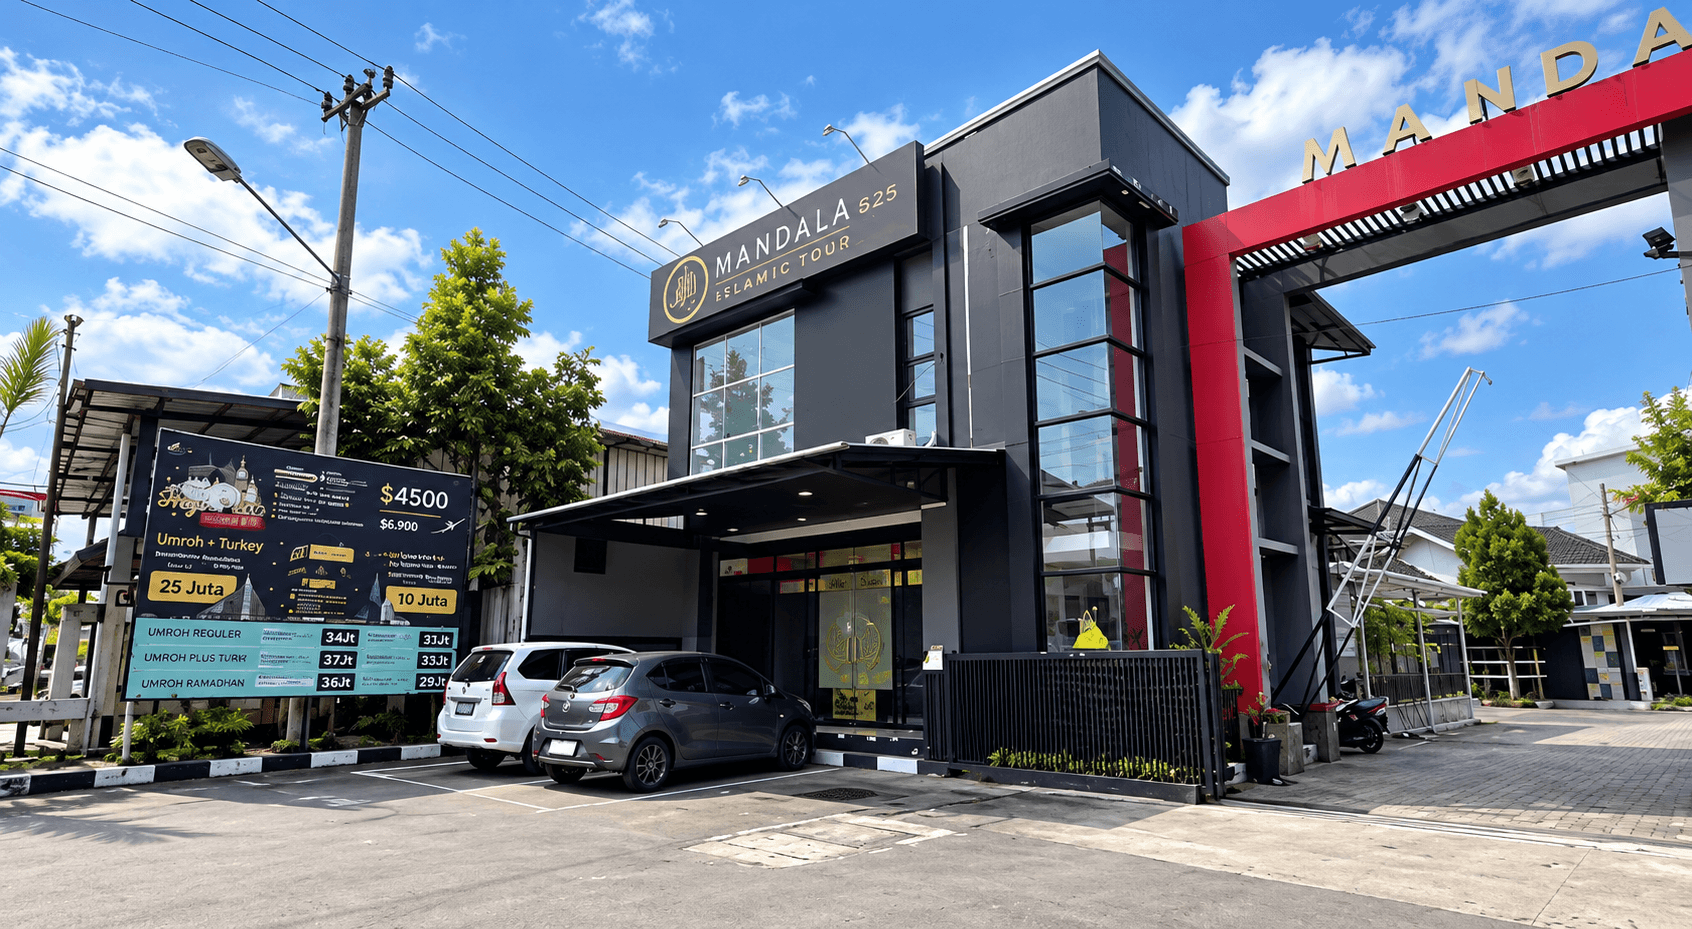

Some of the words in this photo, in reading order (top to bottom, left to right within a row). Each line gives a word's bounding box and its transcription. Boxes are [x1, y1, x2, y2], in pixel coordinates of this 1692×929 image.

[1301, 6, 1692, 184] MANDA
[715, 198, 850, 278] MANDALA
[799, 235, 850, 267] TOUR
[380, 482, 448, 509] $4500
[380, 518, 418, 532] $6.900
[157, 532, 204, 547] Umroh
[219, 537, 264, 554] Turkey
[159, 579, 182, 594] 25
[186, 580, 224, 596] Juta
[398, 593, 414, 605] 10
[418, 594, 448, 607] Juta
[148, 627, 190, 637] UMROH
[193, 629, 242, 638] REGULER
[325, 632, 355, 643] 34Jt
[144, 653, 186, 662] UMROH
[189, 653, 216, 662] PLUS
[323, 654, 353, 666] 37Jt
[141, 679, 183, 688] UMROH
[186, 679, 245, 688] RAMADHAN
[321, 676, 351, 688] 36Jt
